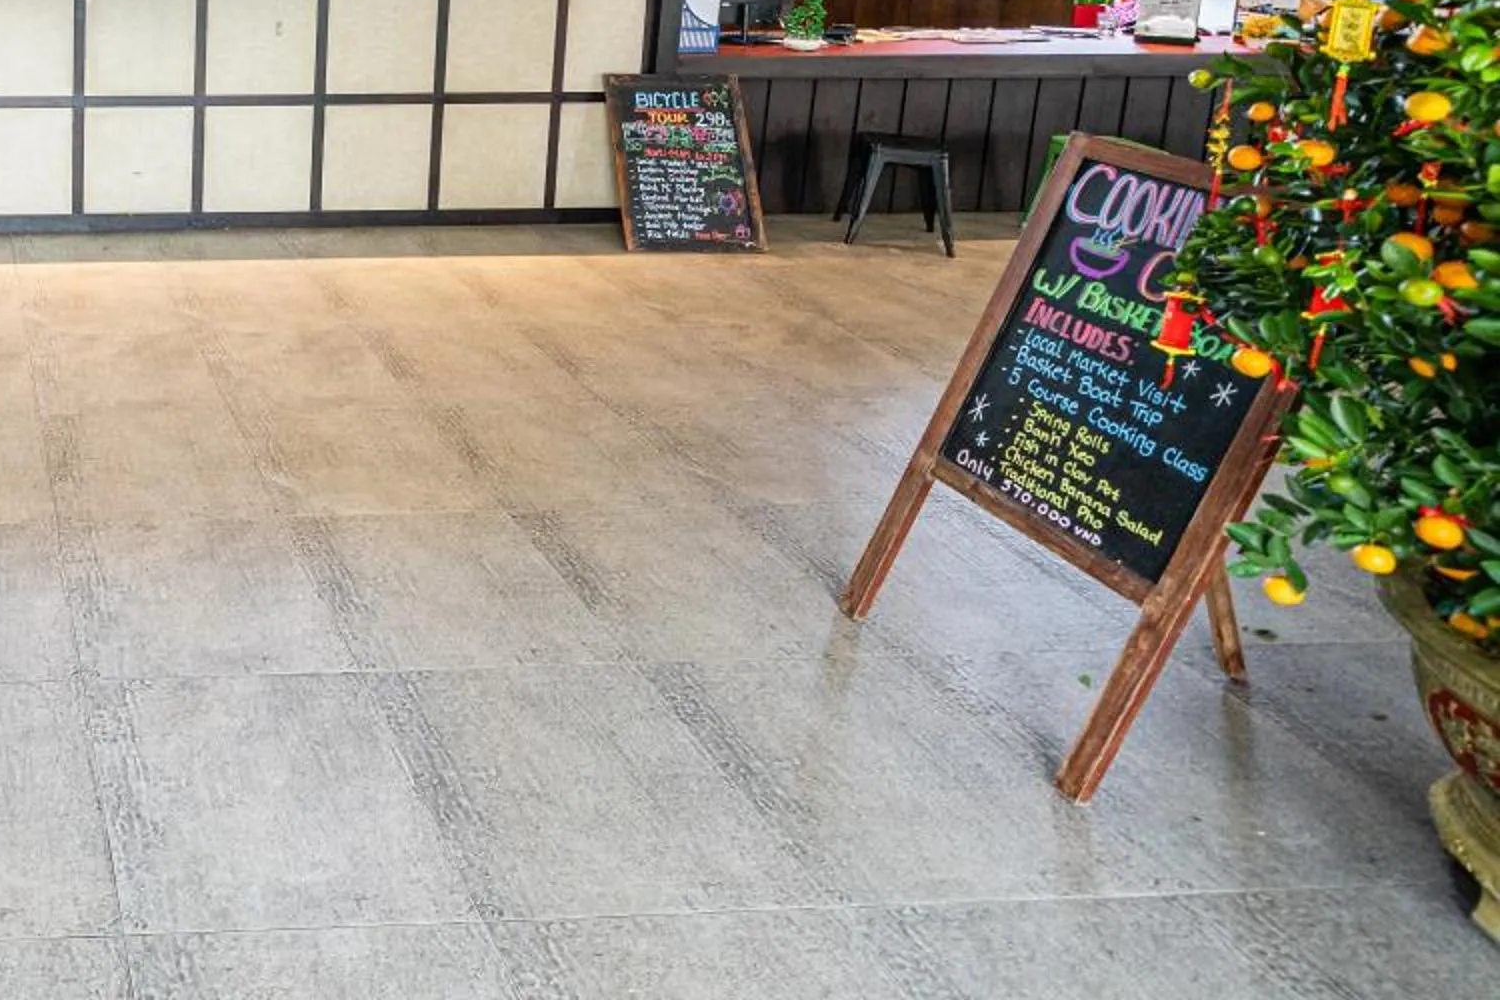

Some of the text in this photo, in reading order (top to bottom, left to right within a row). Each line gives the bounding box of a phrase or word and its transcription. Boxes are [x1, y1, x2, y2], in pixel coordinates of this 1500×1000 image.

[635, 91, 700, 109] BICYCLE
[647, 111, 689, 125] TOUR
[1066, 163, 1206, 254] COOKI
[1067, 350, 1131, 387] Market
[1138, 379, 1188, 415] Visit
[1077, 375, 1124, 408] Boat
[1129, 399, 1164, 428] Trip
[1027, 378, 1080, 416] Course
[1087, 406, 1158, 458] Cooking
[1161, 446, 1210, 483] Class
[1028, 400, 1112, 455] Spring Rolls
[1067, 440, 1096, 467] Xeo
[956, 448, 995, 481] Only
[1013, 431, 1040, 456] Fish
[1044, 448, 1059, 467] in
[1096, 479, 1122, 502] Pot
[999, 460, 1104, 530] Traditional Pho
[1005, 445, 1164, 547] Chicken Banana Salad
